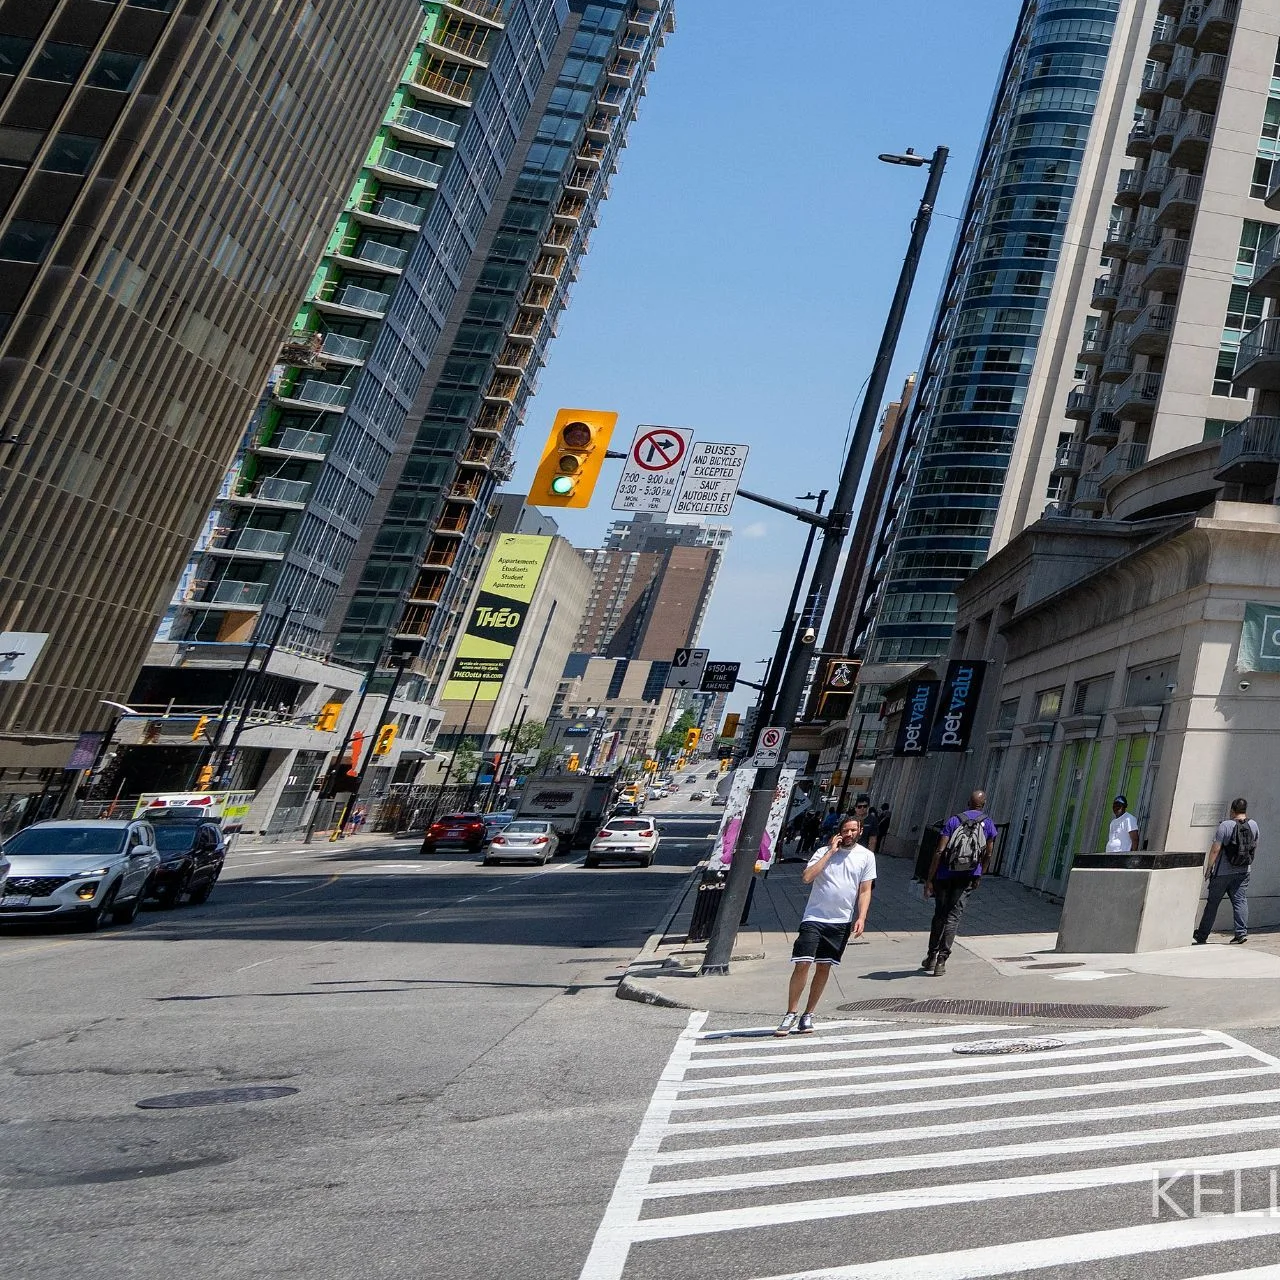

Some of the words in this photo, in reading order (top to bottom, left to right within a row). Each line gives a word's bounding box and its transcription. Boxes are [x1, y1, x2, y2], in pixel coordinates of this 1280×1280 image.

[704, 445, 737, 456] BUSES
[692, 457, 707, 465] AND
[709, 458, 742, 467] BICYCLES
[694, 467, 734, 477] EXCEPTED
[624, 473, 640, 483] 7:00
[647, 474, 664, 484] 9:00
[620, 485, 637, 494] 3:30
[644, 486, 661, 496] 5:30
[700, 480, 721, 490] SAUF
[682, 490, 718, 501] AUTOBUS
[721, 493, 731, 502] ET
[678, 502, 729, 513] BICYCLETTES
[498, 558, 538, 566] Appartements
[492, 581, 526, 589] Apartments
[707, 664, 738, 673] $150.00
[949, 666, 974, 710] valu
[910, 685, 930, 723] valu
[941, 711, 963, 746] pet
[903, 723, 922, 752] pet
